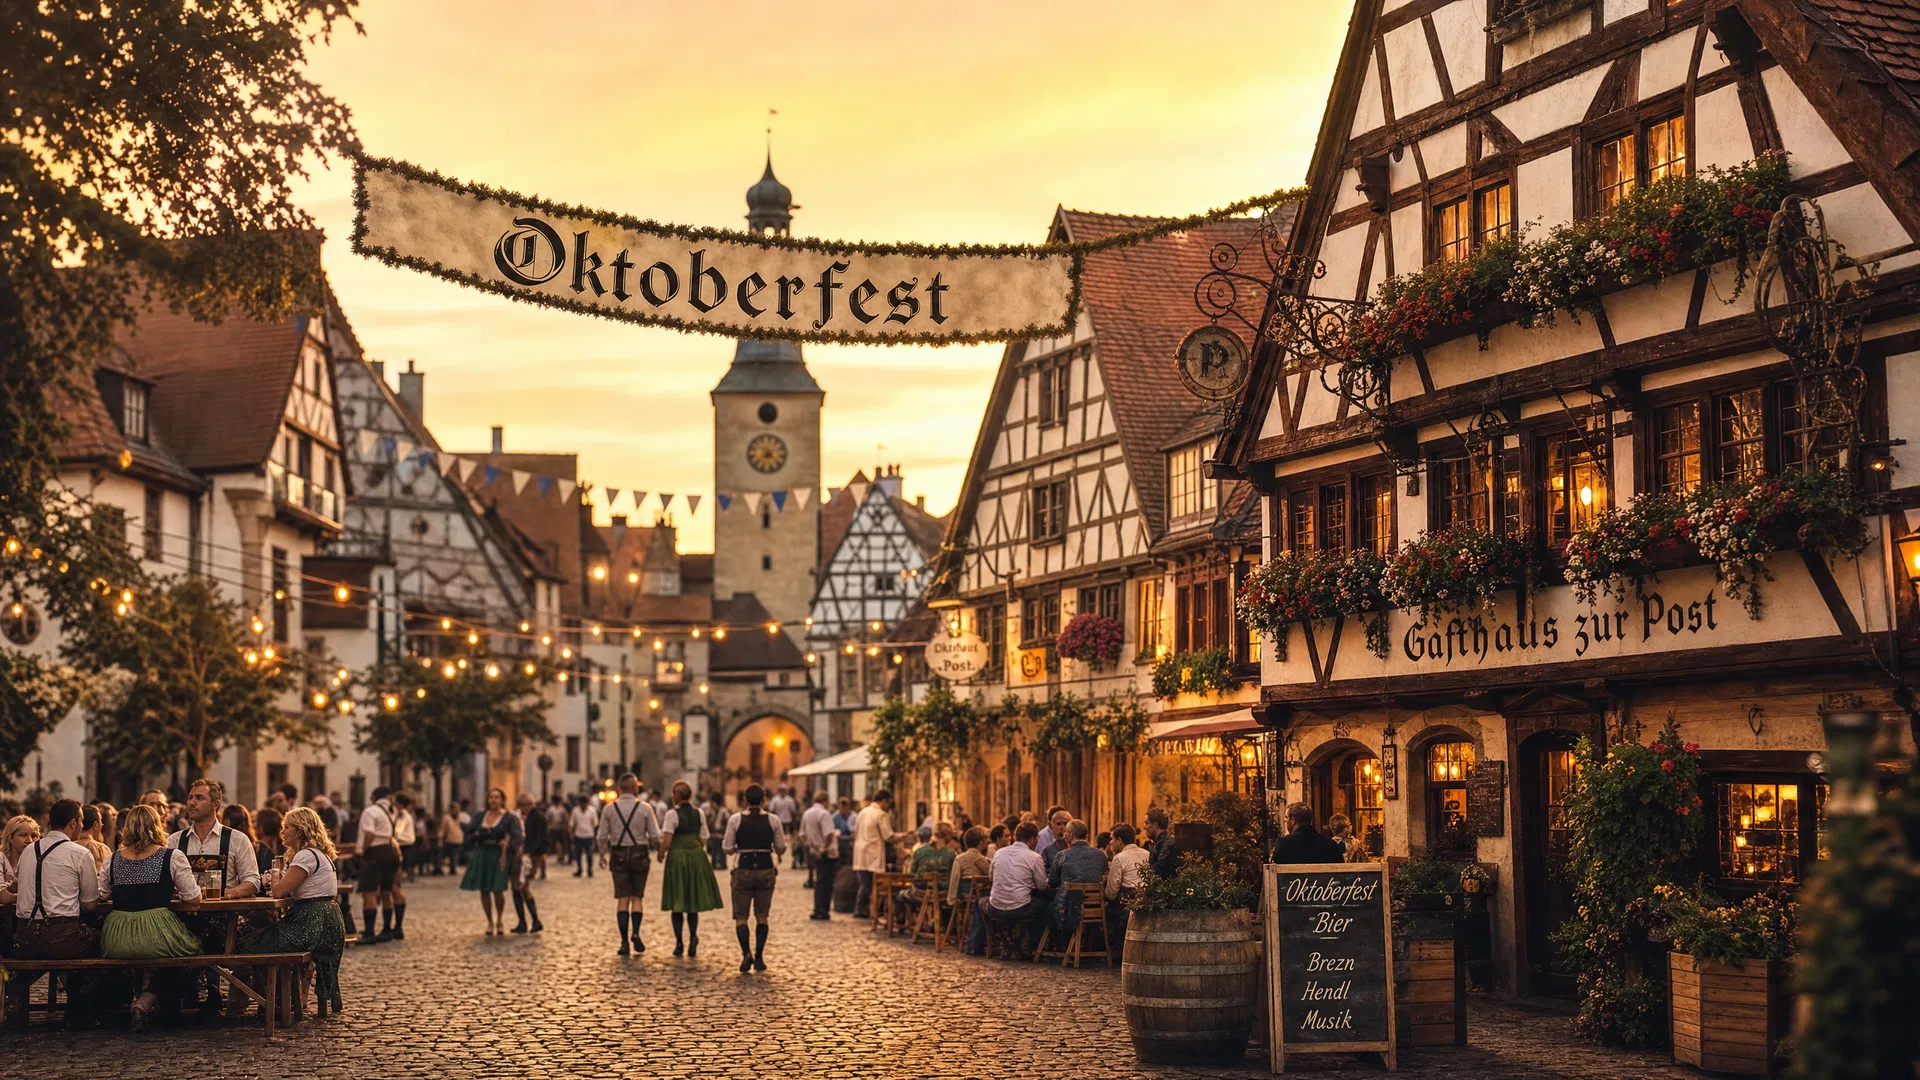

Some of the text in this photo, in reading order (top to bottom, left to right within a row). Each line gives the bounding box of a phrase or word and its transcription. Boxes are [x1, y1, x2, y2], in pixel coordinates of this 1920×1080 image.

[494, 216, 950, 331] Oktoberfest
[1574, 611, 1629, 657] zur
[1641, 589, 1717, 643] Post
[1286, 877, 1378, 906] Oktoberfest
[1313, 911, 1353, 933] Bier
[1306, 951, 1355, 972] Brezn
[1301, 980, 1351, 1001] Hendl
[1301, 1008, 1352, 1029] Musik
